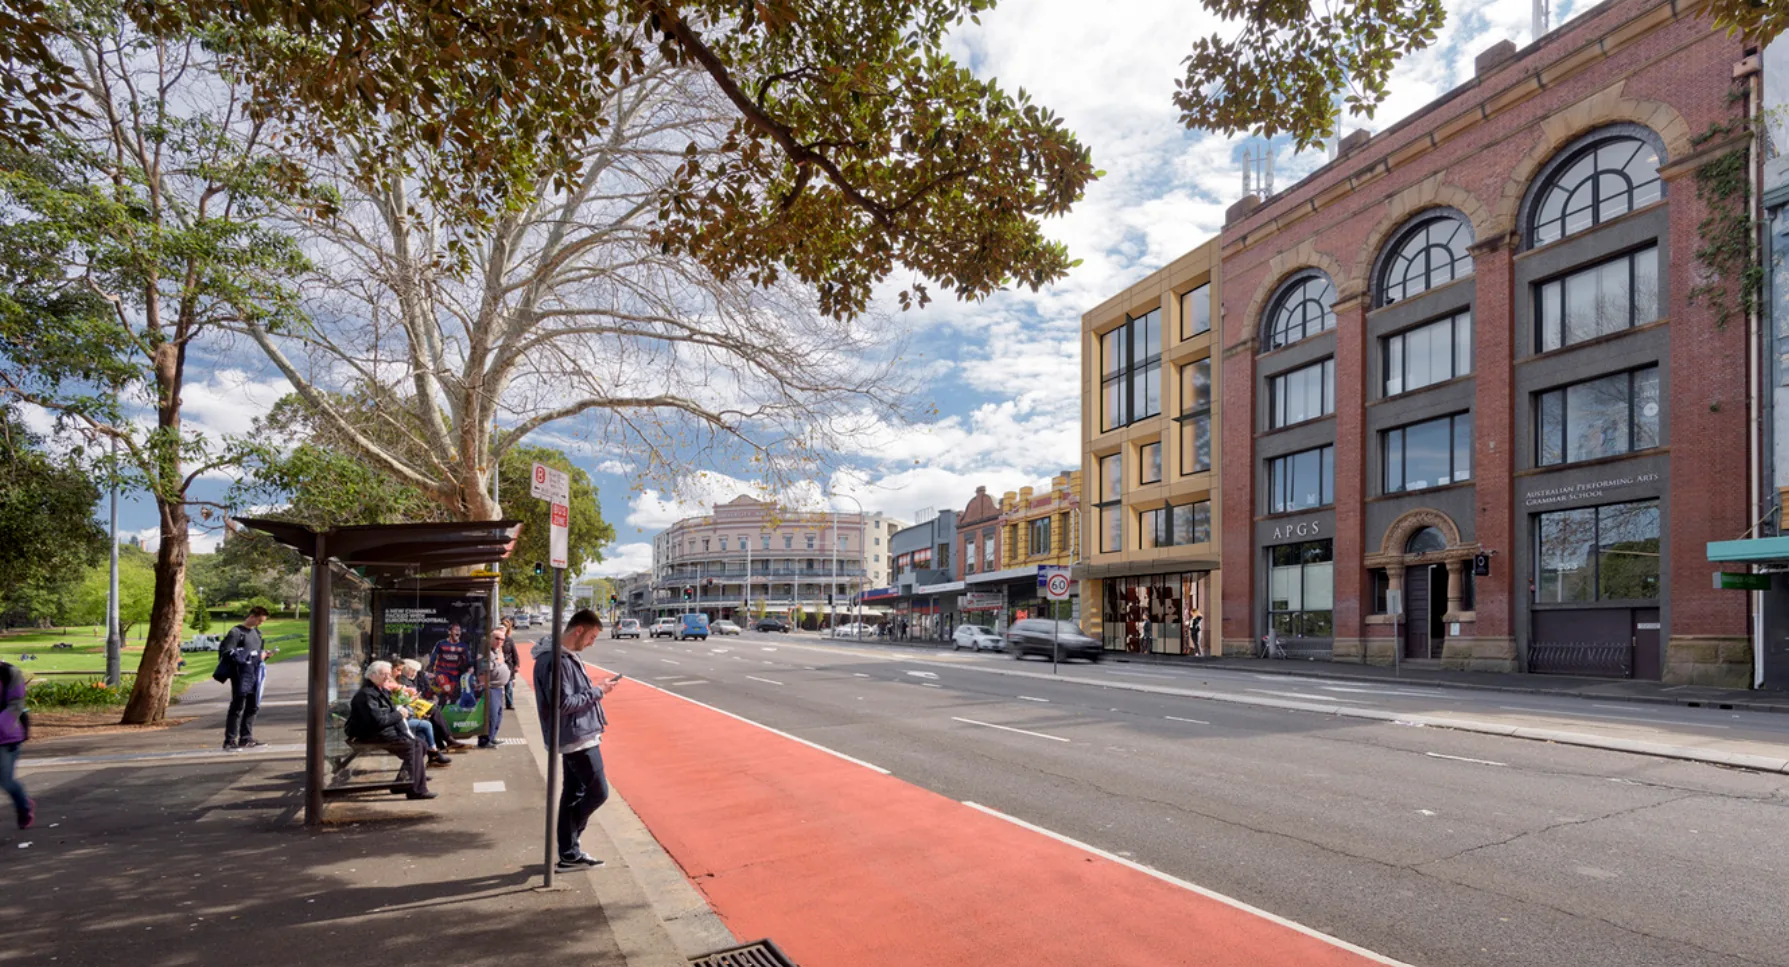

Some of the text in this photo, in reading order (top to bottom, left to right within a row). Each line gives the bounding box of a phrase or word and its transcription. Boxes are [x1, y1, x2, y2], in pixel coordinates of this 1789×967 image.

[1526, 474, 1659, 498] AUSTRALIAN PERFORMING ARTS
[1526, 490, 1603, 506] GRAMMAR SCHOOL
[1273, 520, 1319, 539] APGS
[1051, 580, 1066, 590] 60
